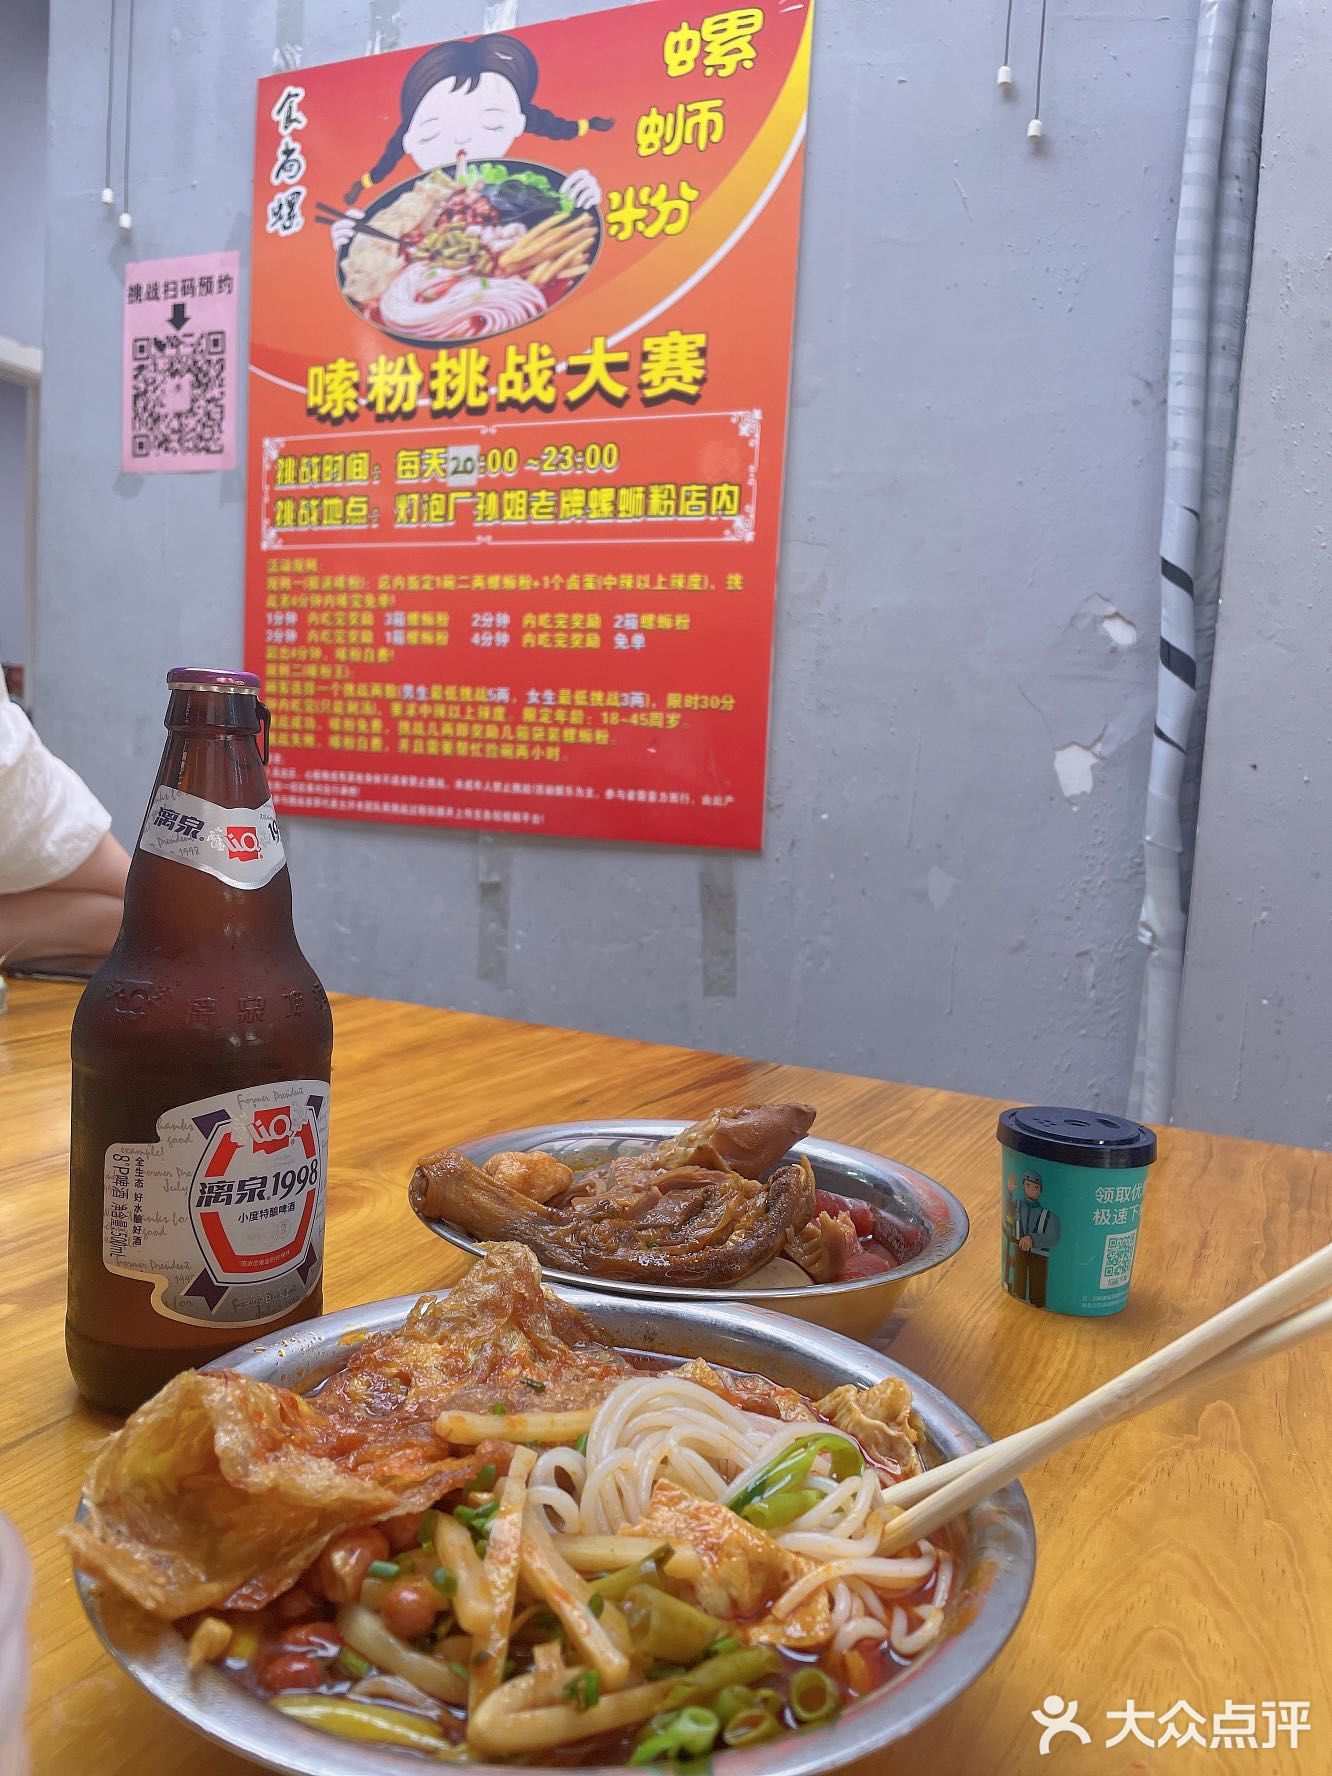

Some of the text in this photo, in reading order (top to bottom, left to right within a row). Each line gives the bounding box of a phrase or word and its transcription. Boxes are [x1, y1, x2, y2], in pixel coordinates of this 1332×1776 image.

[127, 273, 234, 305] 挑战扫码预约
[306, 330, 710, 422] 嗦粉挑战大赛
[522, 612, 602, 630] 内吃完奖励
[522, 631, 602, 649] 内吃完奖励
[613, 632, 646, 650] 免单
[153, 806, 205, 841] 漓泉
[134, 1156, 145, 1189] 全生态
[1095, 1182, 1146, 1204] 领取优
[238, 1201, 296, 1224] 小度特酿啤酒
